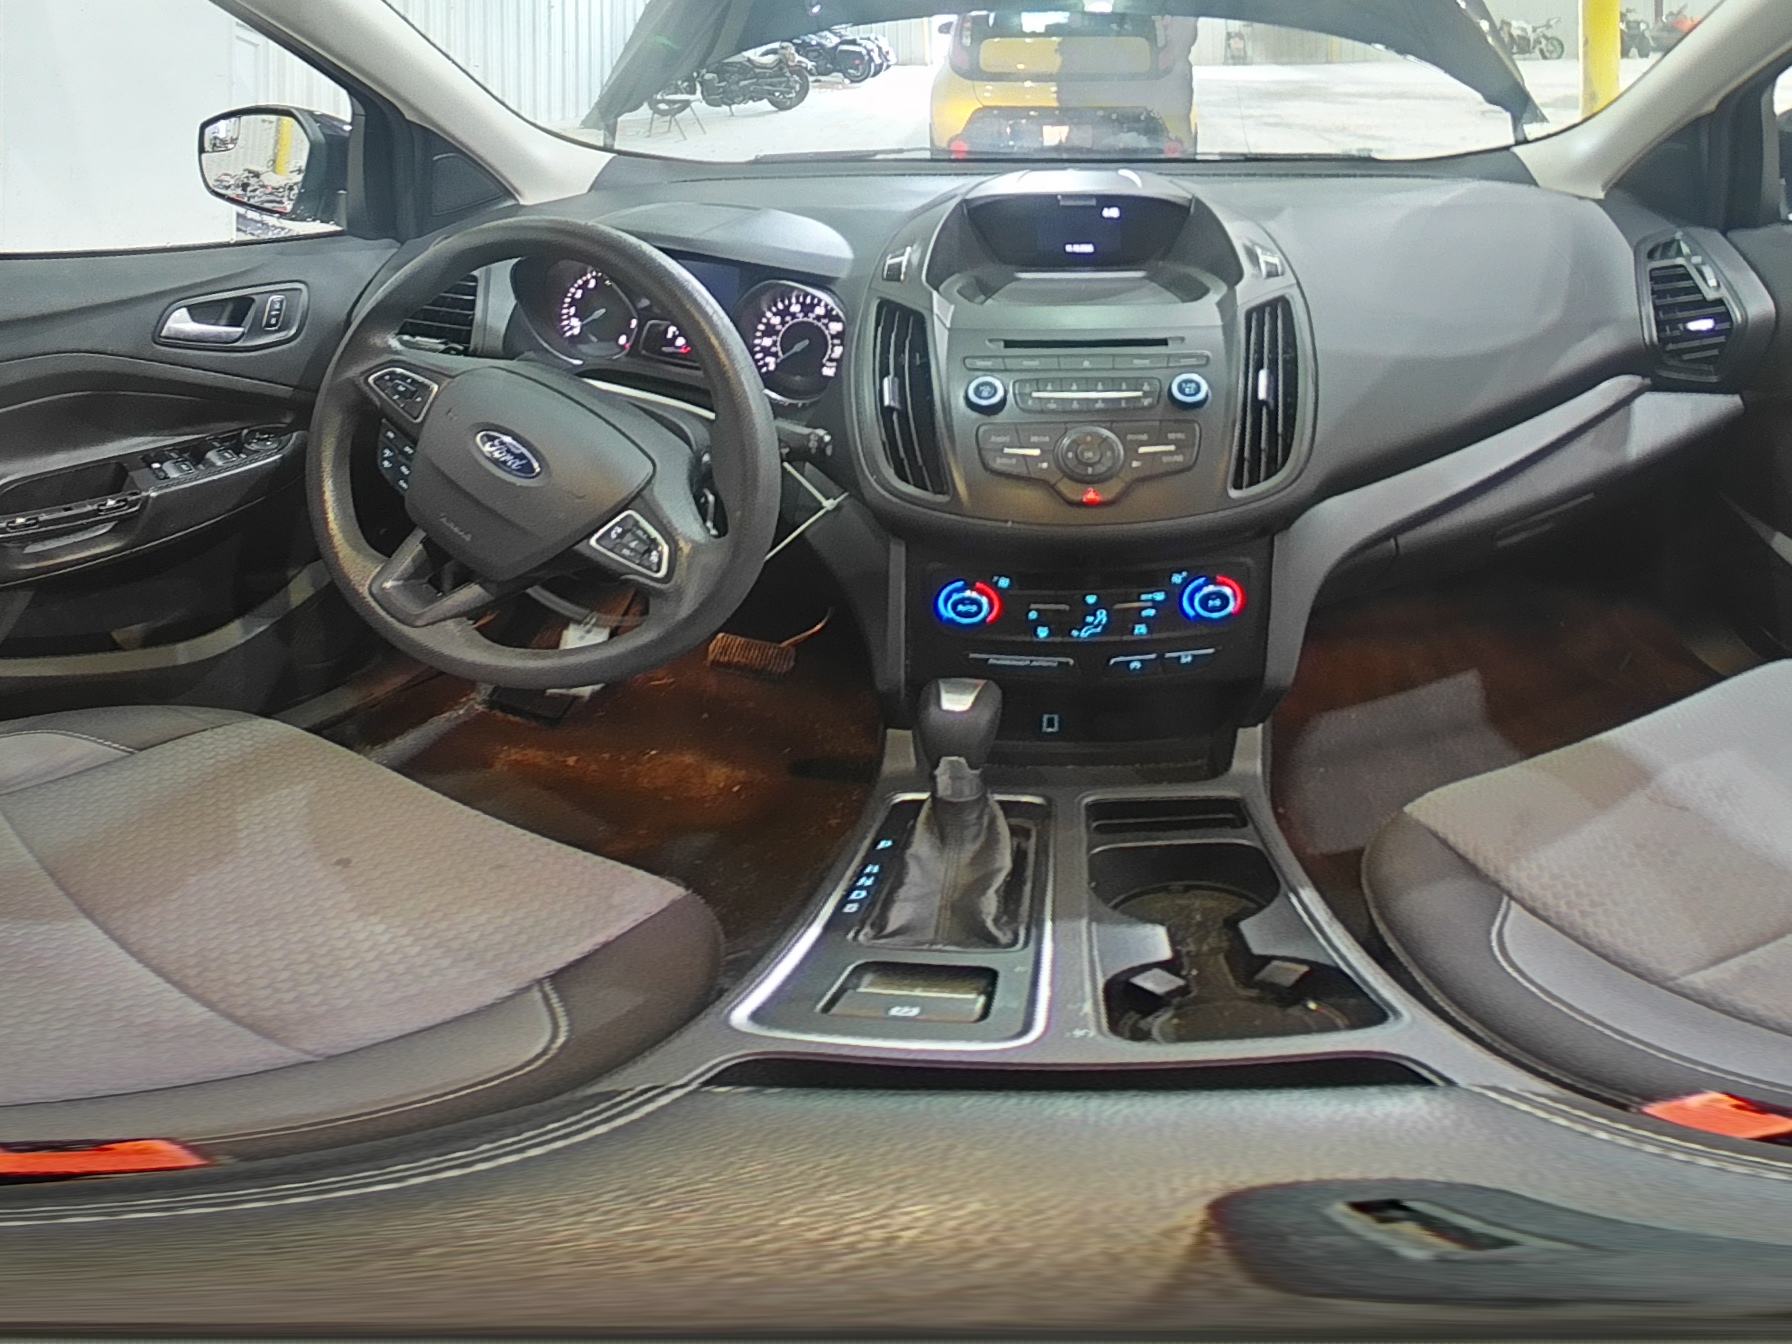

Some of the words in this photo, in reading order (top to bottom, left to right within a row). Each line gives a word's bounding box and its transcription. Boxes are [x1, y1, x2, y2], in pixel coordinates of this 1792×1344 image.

[875, 839, 893, 850] P
[855, 876, 875, 887] N
[847, 889, 868, 900] D
